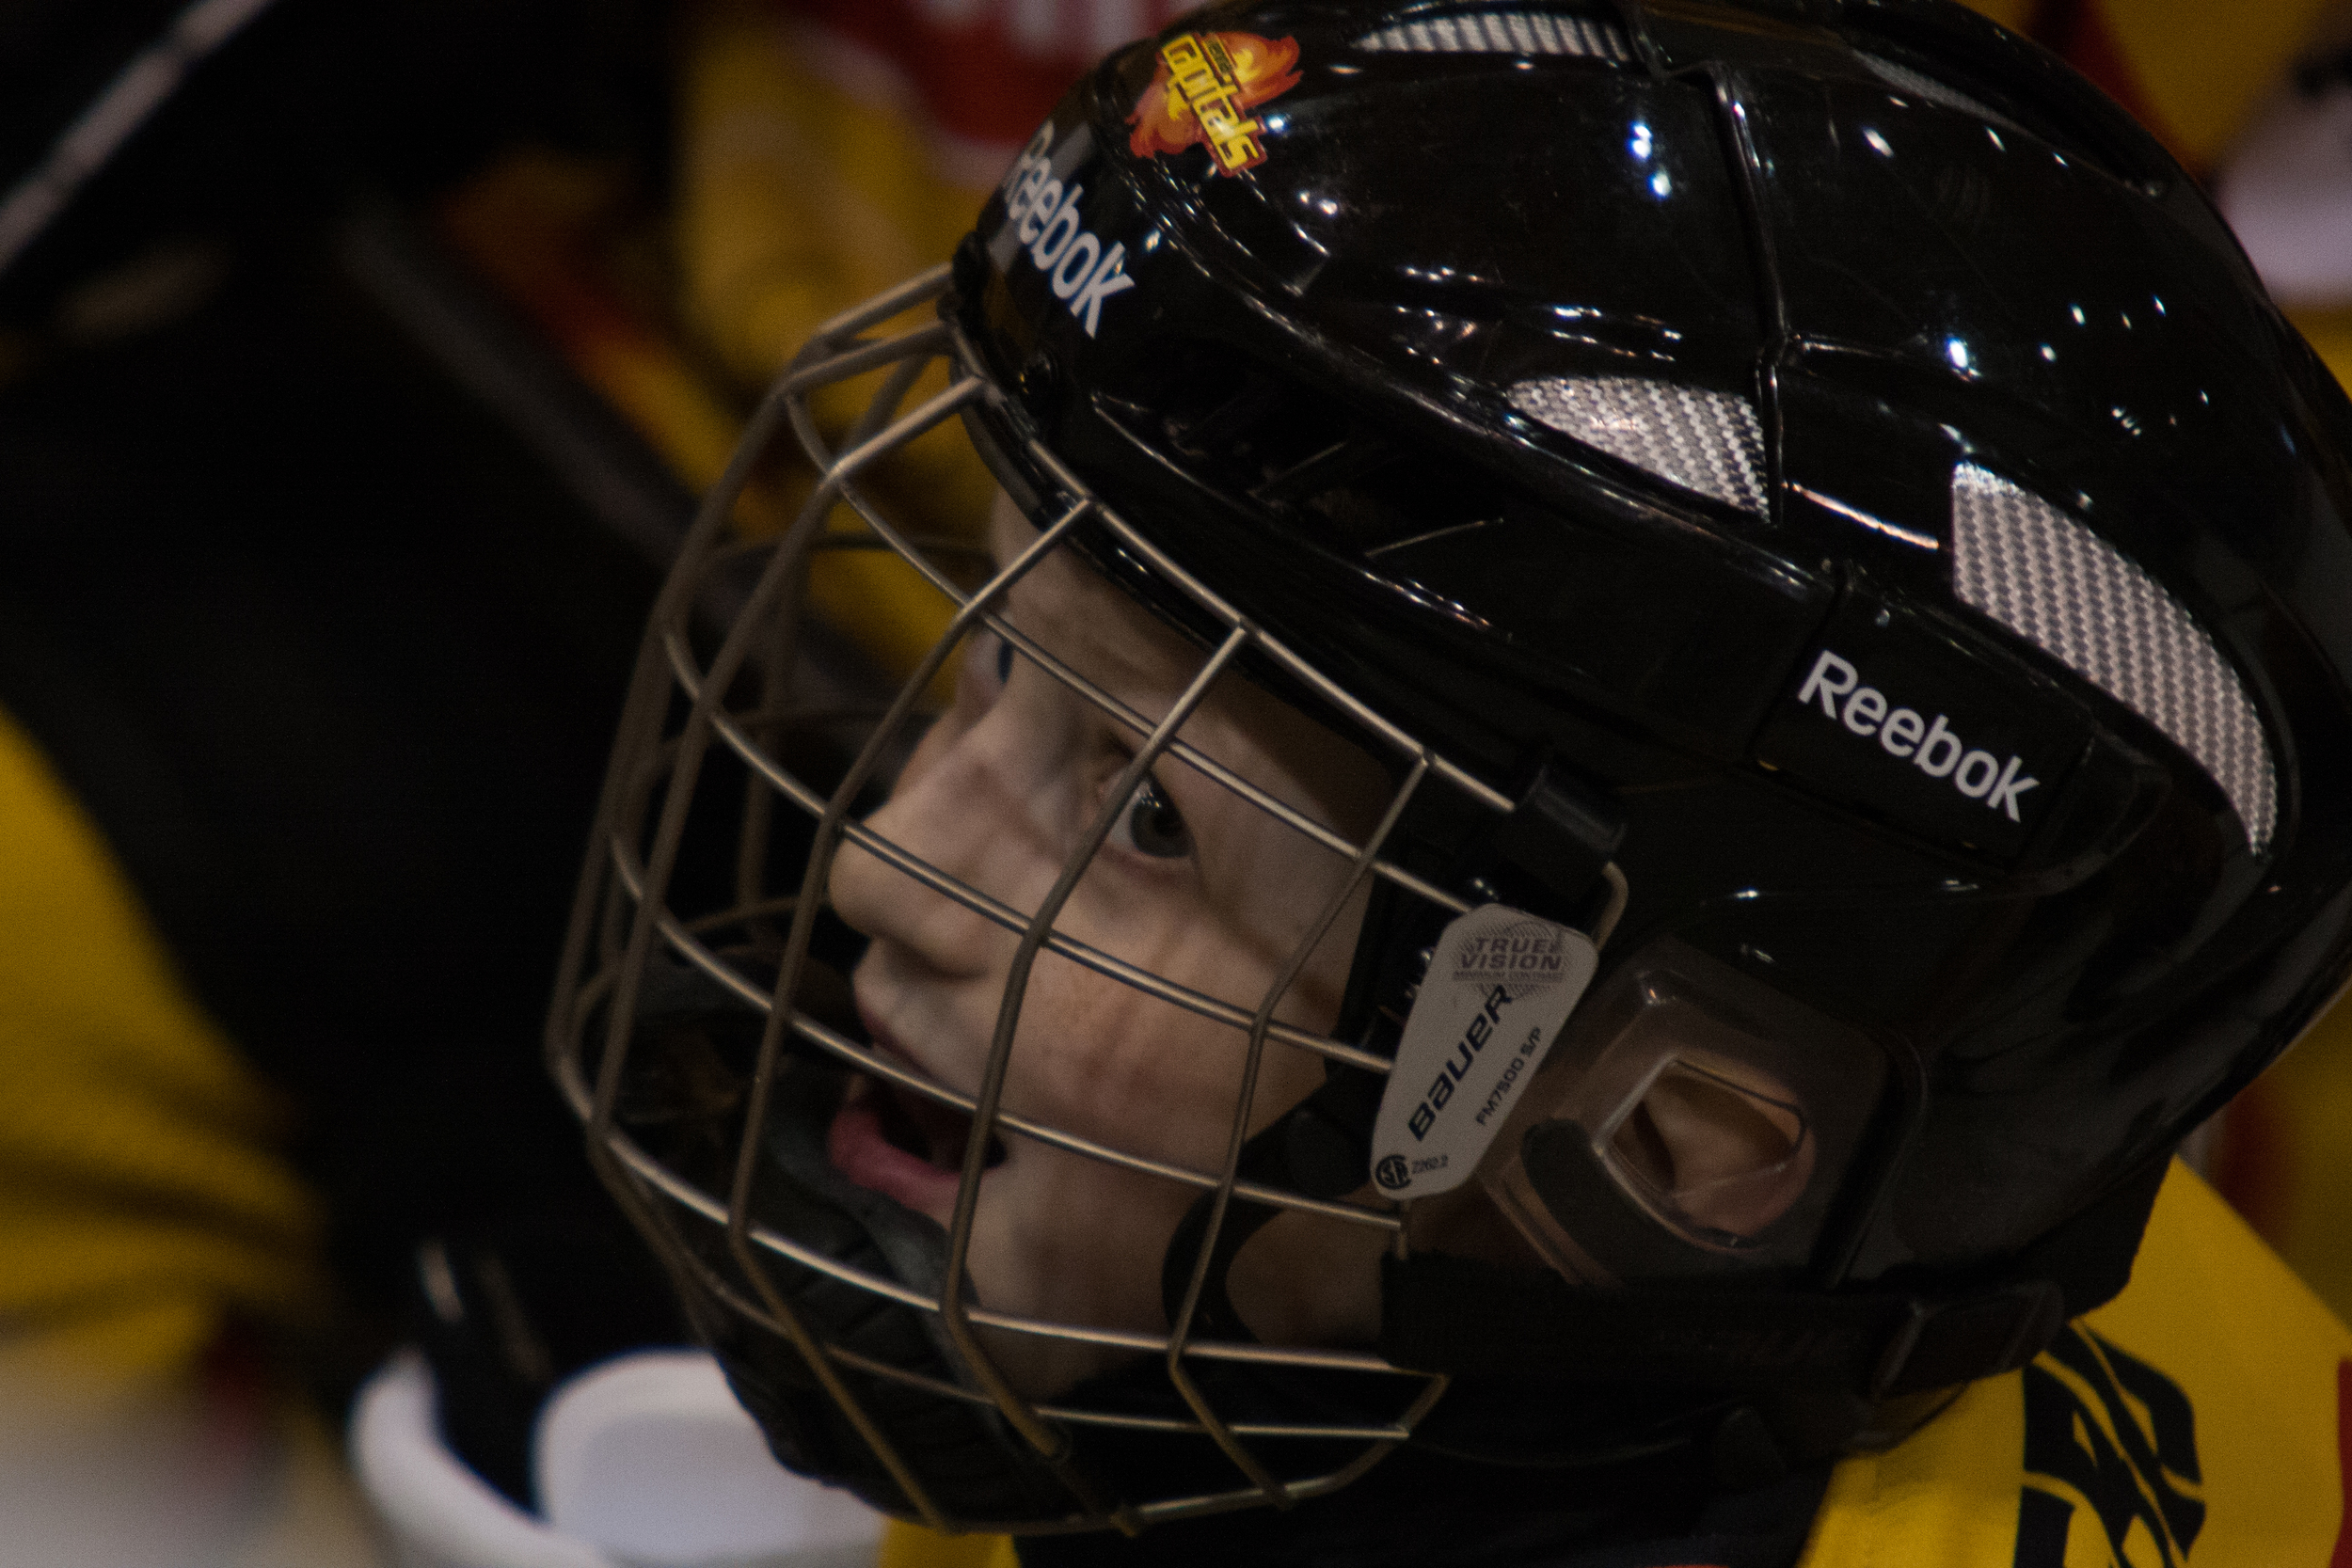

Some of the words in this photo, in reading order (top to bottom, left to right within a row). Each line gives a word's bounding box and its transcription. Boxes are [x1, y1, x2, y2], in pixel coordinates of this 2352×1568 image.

[1003, 119, 1136, 341] Reebok
[1797, 648, 2042, 824] Reebok
[1460, 954, 1563, 971] VISION
[1474, 937, 1548, 954] TRUE
